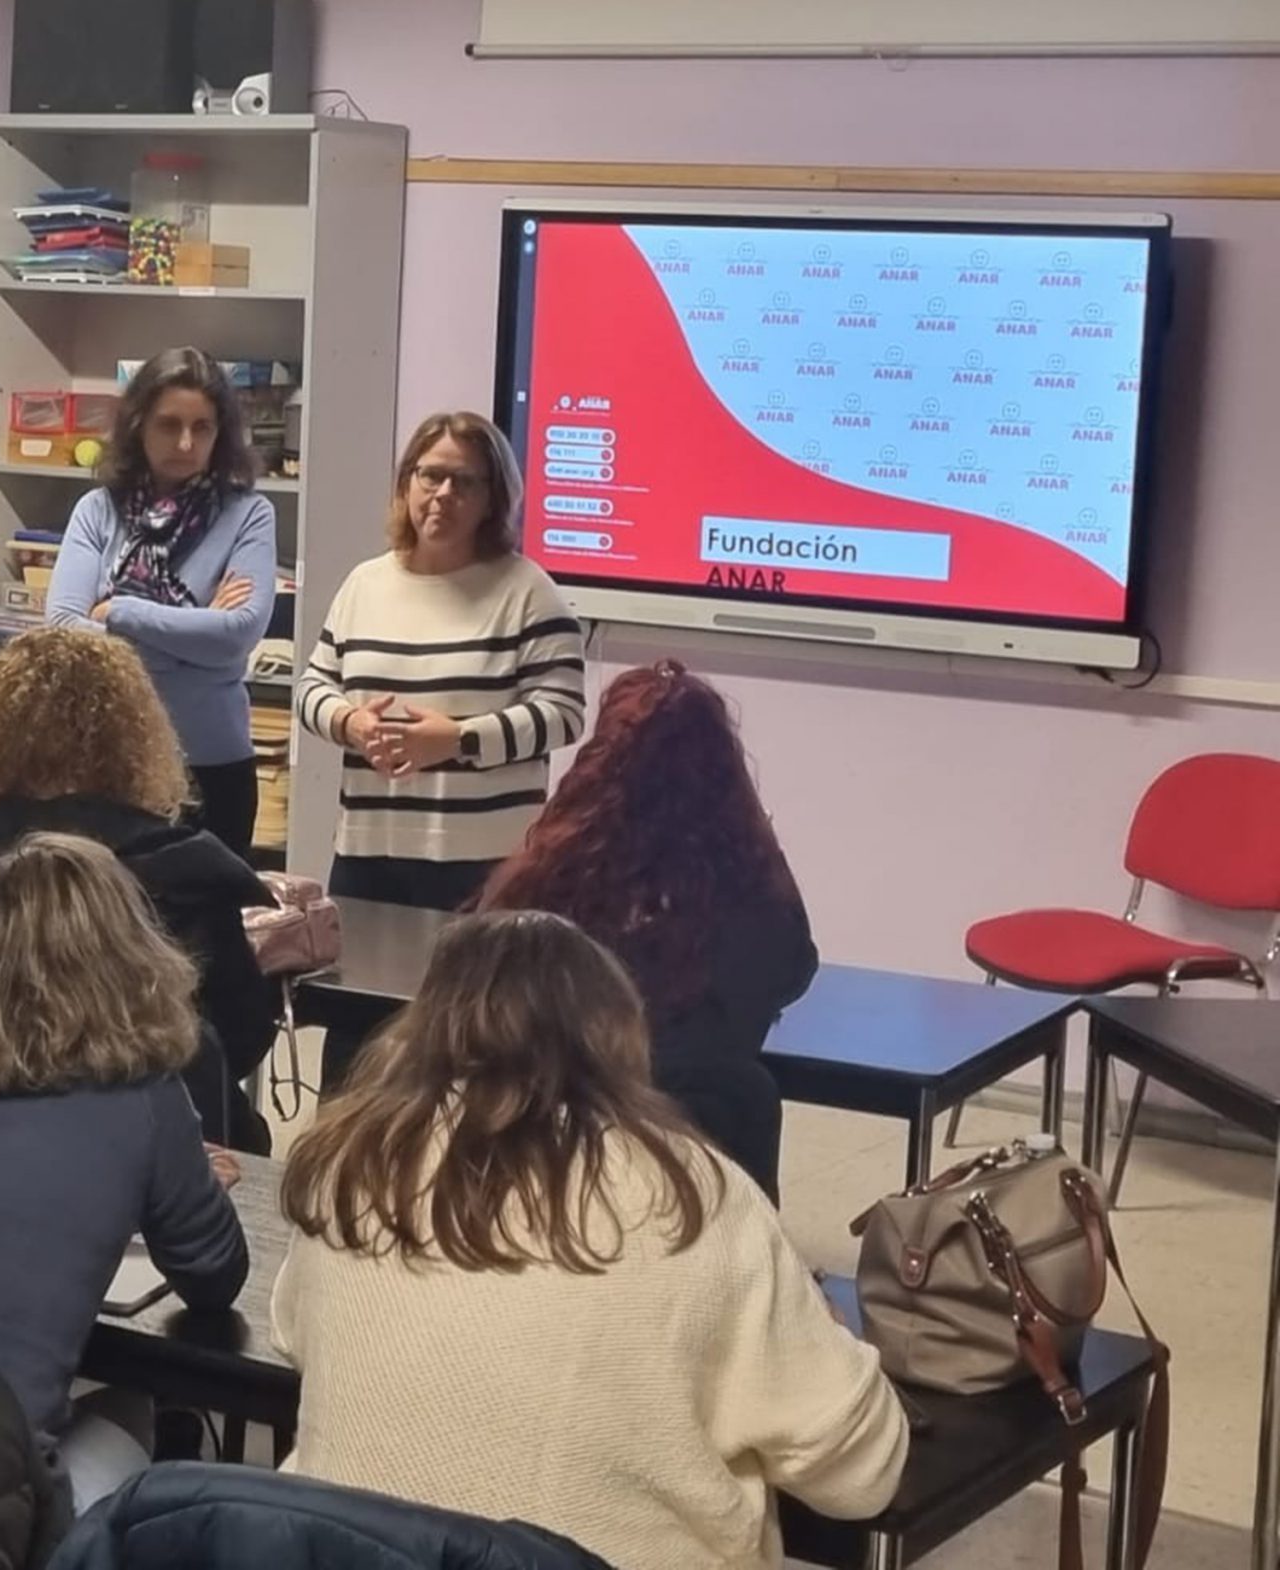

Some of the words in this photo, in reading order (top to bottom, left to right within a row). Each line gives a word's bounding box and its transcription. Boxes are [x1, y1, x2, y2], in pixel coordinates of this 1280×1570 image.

[727, 265, 764, 276] ANAR
[802, 267, 840, 279] ANAR
[879, 270, 918, 281] ANAR
[959, 272, 999, 284] ANAR
[1040, 276, 1081, 287] ANAR
[688, 310, 724, 321] ANAR
[762, 313, 799, 325] ANAR
[838, 316, 876, 328] ANAR
[916, 319, 956, 331] ANAR
[996, 323, 1037, 335] ANAR
[1071, 326, 1112, 338] ANAR
[722, 361, 759, 372] ANAR
[797, 365, 835, 377] ANAR
[874, 369, 912, 380] ANAR
[953, 372, 992, 384] ANAR
[1034, 377, 1075, 388] ANAR
[756, 411, 794, 423] ANAR
[832, 416, 871, 427] ANAR
[910, 420, 949, 432] ANAR
[990, 425, 1030, 436] ANAR
[1072, 430, 1113, 441] ANAR
[868, 467, 907, 478] ANAR
[947, 472, 987, 484] ANAR
[1027, 478, 1068, 490] ANAR
[1066, 532, 1107, 544] ANAR
[707, 527, 857, 562] Fundación
[706, 566, 787, 592] ANAR
